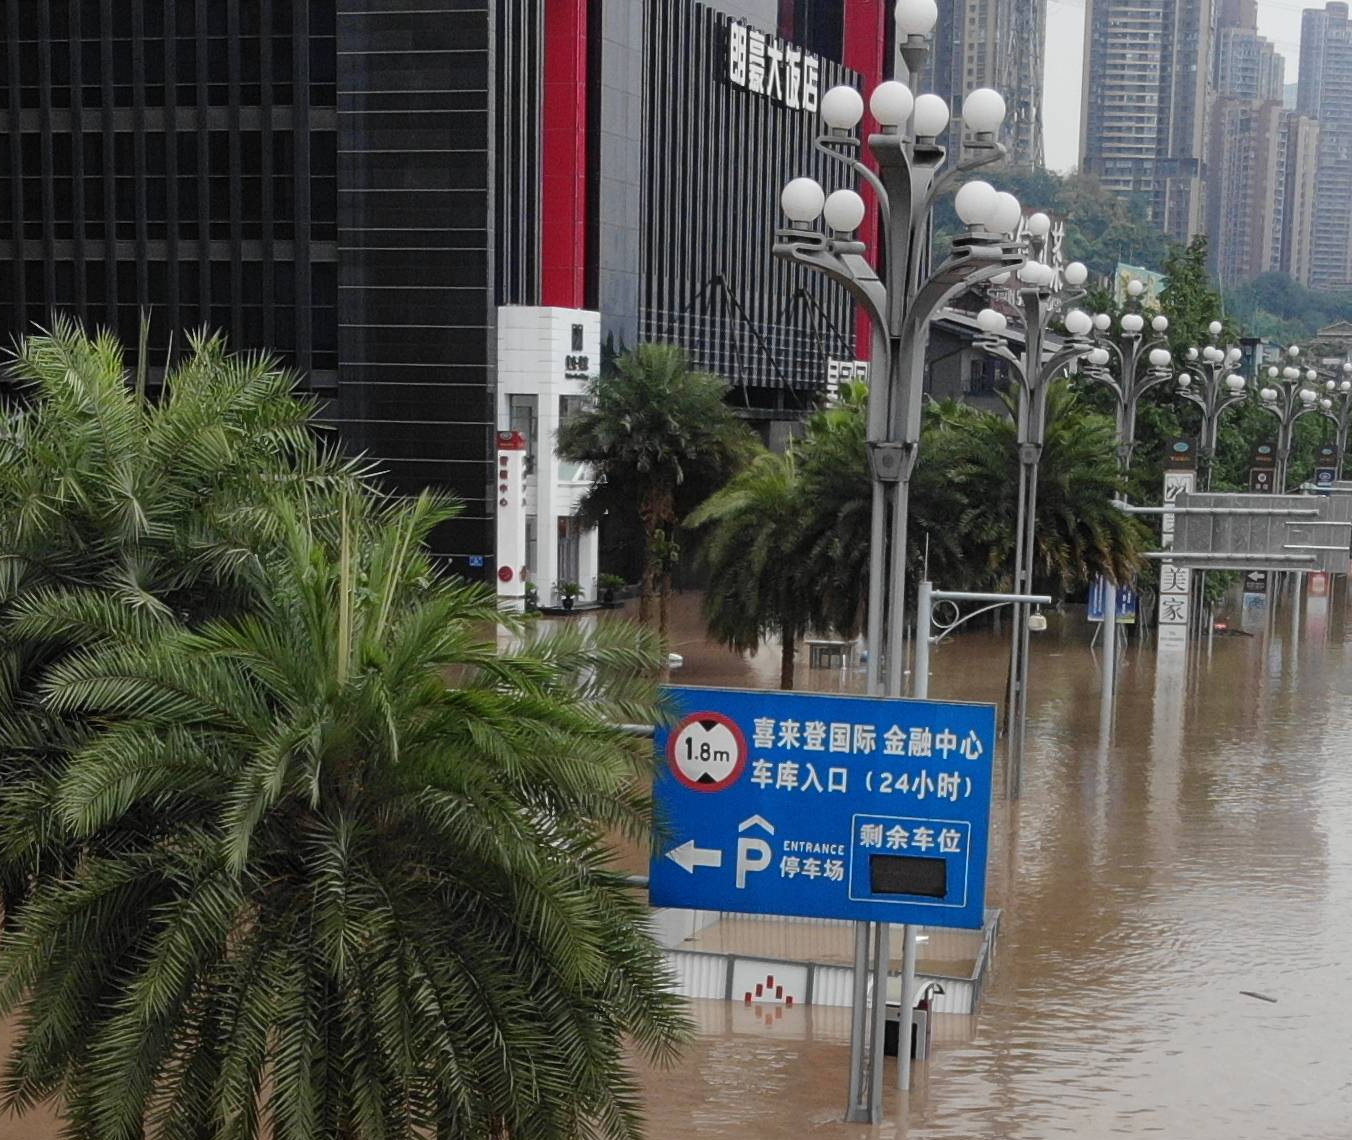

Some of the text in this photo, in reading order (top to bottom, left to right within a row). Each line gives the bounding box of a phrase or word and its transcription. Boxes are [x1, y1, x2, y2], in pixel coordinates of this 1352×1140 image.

[730, 22, 818, 113] 朗豪大饭店
[685, 737, 730, 762] 1.8m
[783, 840, 845, 855] ENTRANCE
[859, 823, 962, 853] 剩余车位
[736, 837, 772, 889] P
[779, 855, 845, 882] 停车场
